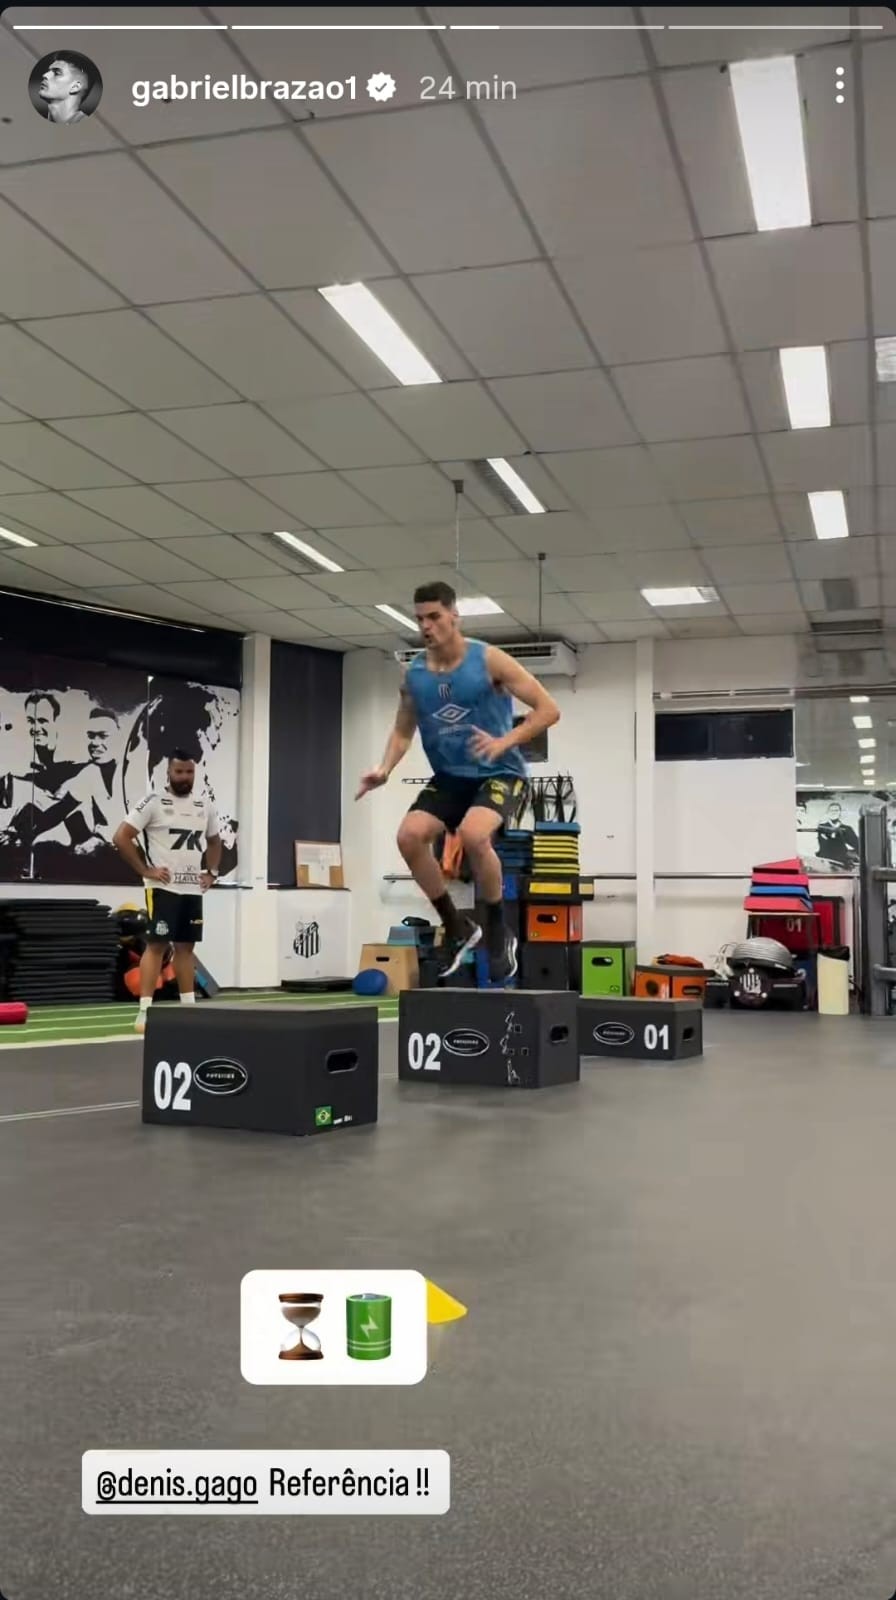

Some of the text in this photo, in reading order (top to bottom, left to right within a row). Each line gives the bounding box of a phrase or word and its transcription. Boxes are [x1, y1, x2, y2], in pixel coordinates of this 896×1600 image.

[169, 828, 204, 852] 7K
[786, 917, 803, 933] 01
[644, 1024, 670, 1051] 01
[408, 1032, 441, 1071] 02
[153, 1060, 193, 1111] 02
